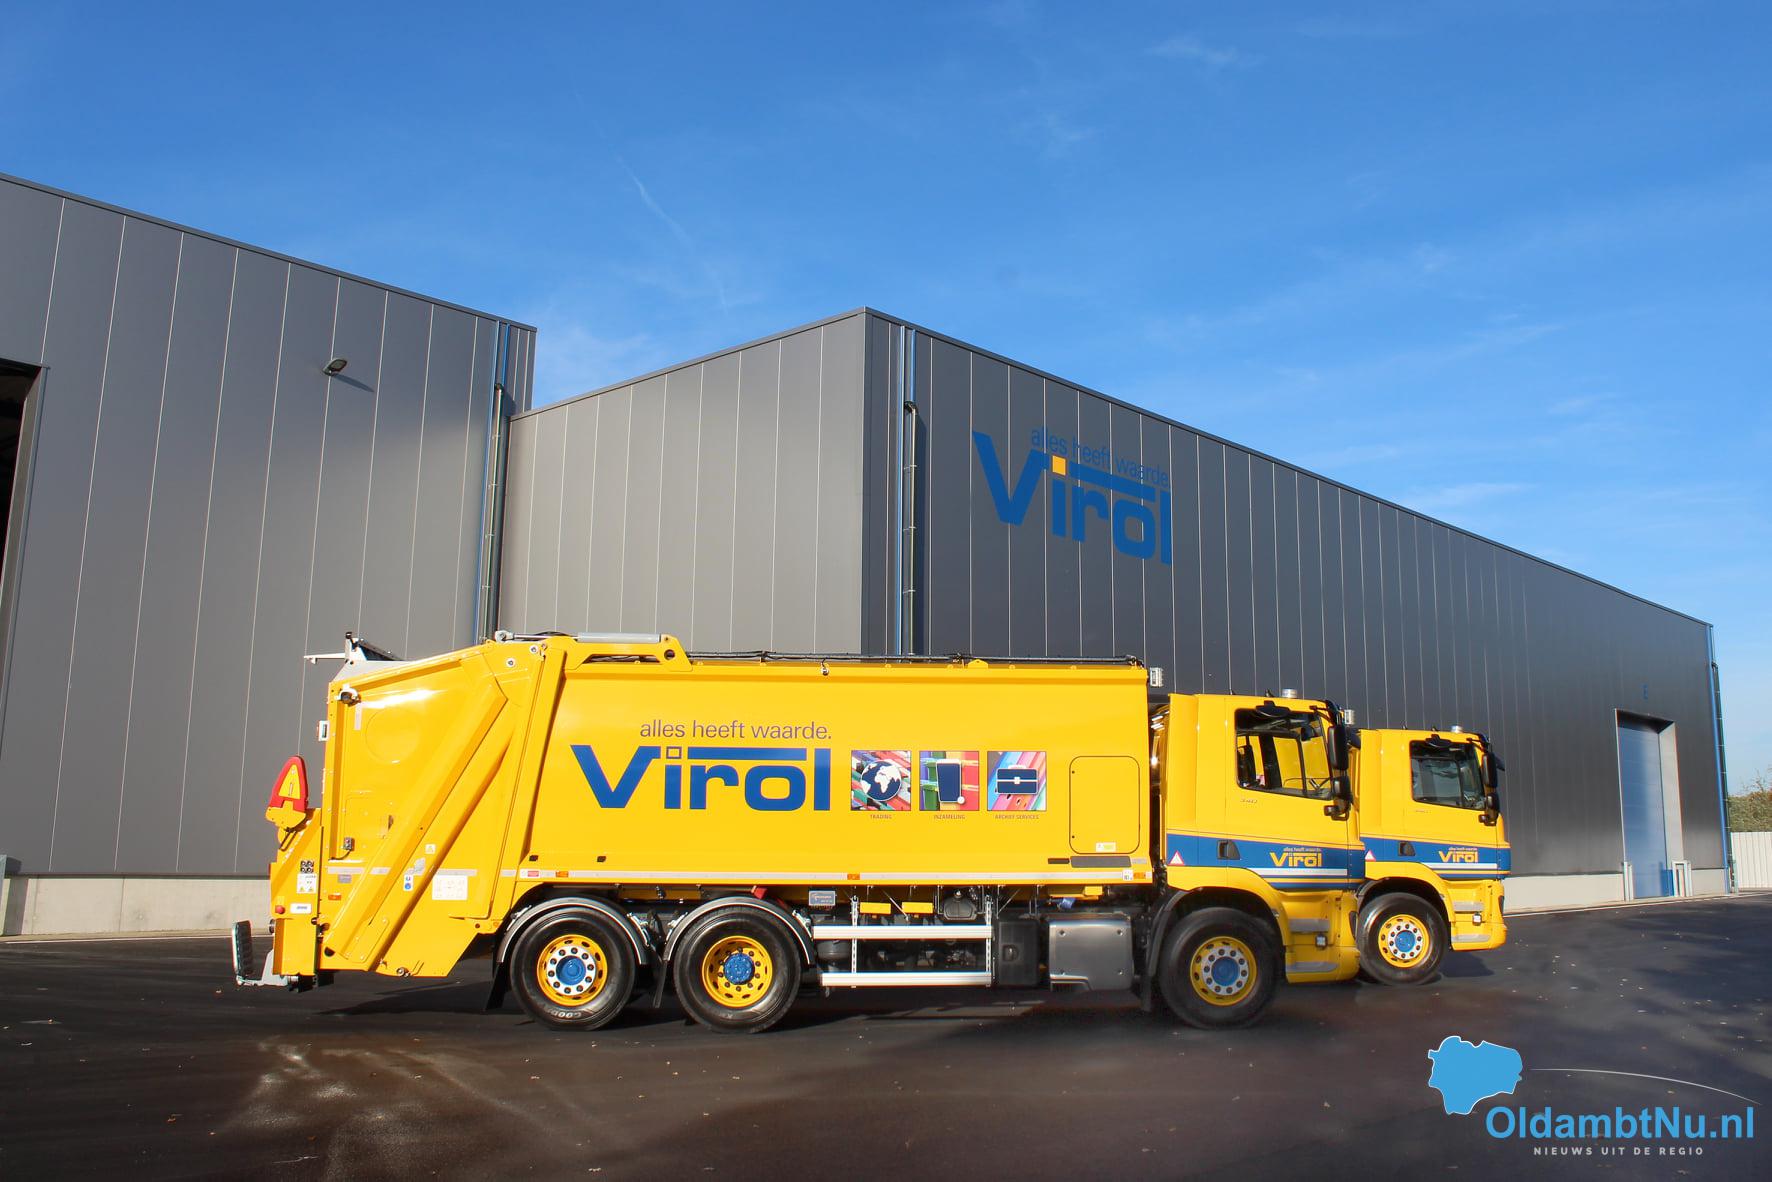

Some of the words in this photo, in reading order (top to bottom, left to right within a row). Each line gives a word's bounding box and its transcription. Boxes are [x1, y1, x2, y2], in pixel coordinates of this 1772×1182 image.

[1031, 426, 1068, 455] alles
[1072, 437, 1111, 469] heeft
[972, 431, 1171, 566] Virol
[640, 720, 685, 738] alles
[692, 720, 745, 738] heeft
[751, 721, 832, 740] waarde.
[570, 744, 832, 812] Virol
[1269, 851, 1323, 868] Virol
[1438, 850, 1479, 863] Virol
